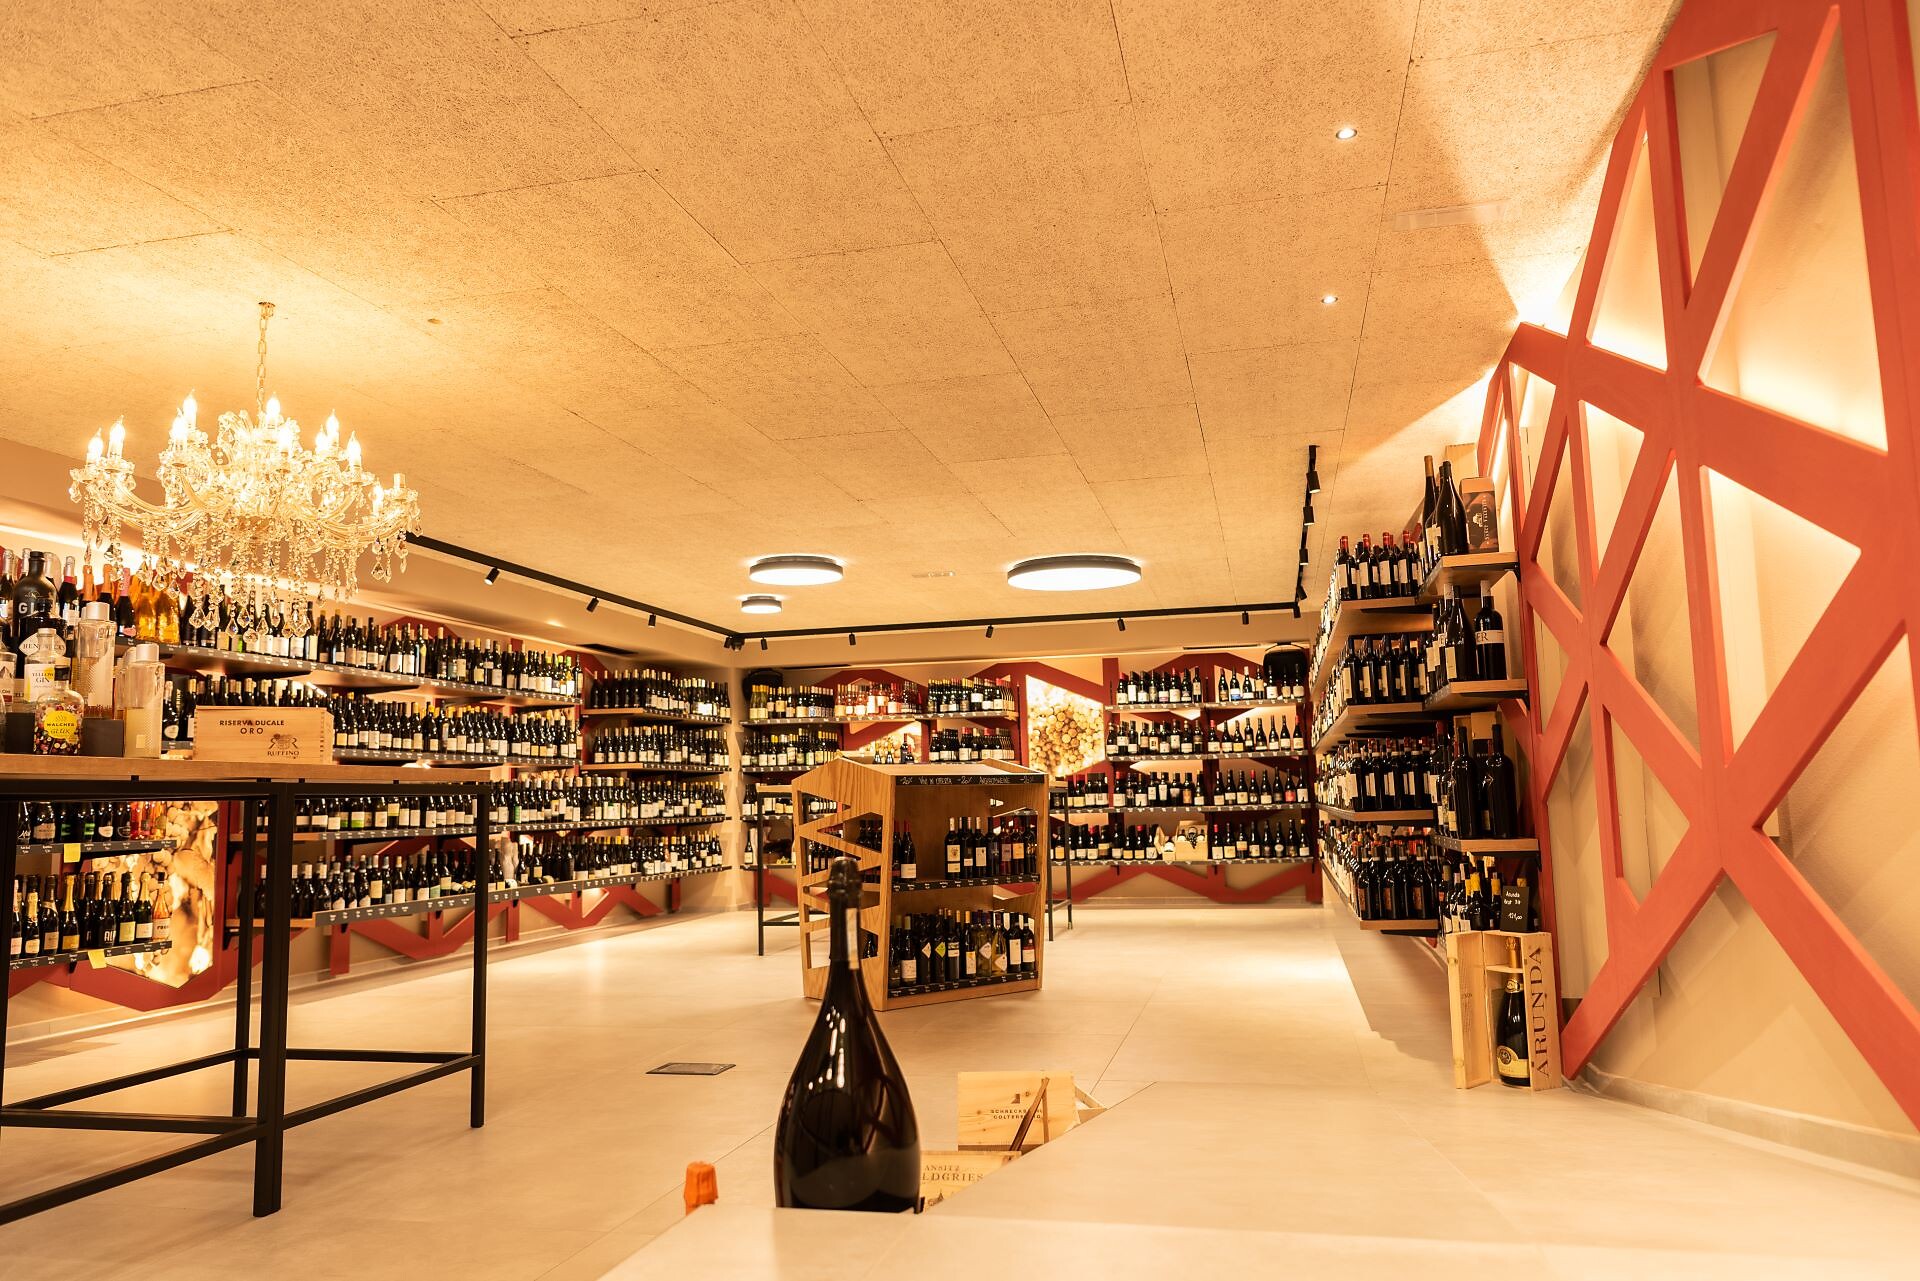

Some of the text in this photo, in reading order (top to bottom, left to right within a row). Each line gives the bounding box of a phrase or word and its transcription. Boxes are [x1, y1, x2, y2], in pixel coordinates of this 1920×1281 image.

[219, 719, 253, 727] RISERVA
[240, 727, 264, 735] ORO
[1528, 947, 1550, 1080] ARUNDA
[921, 1172, 984, 1182] LDGRIES
